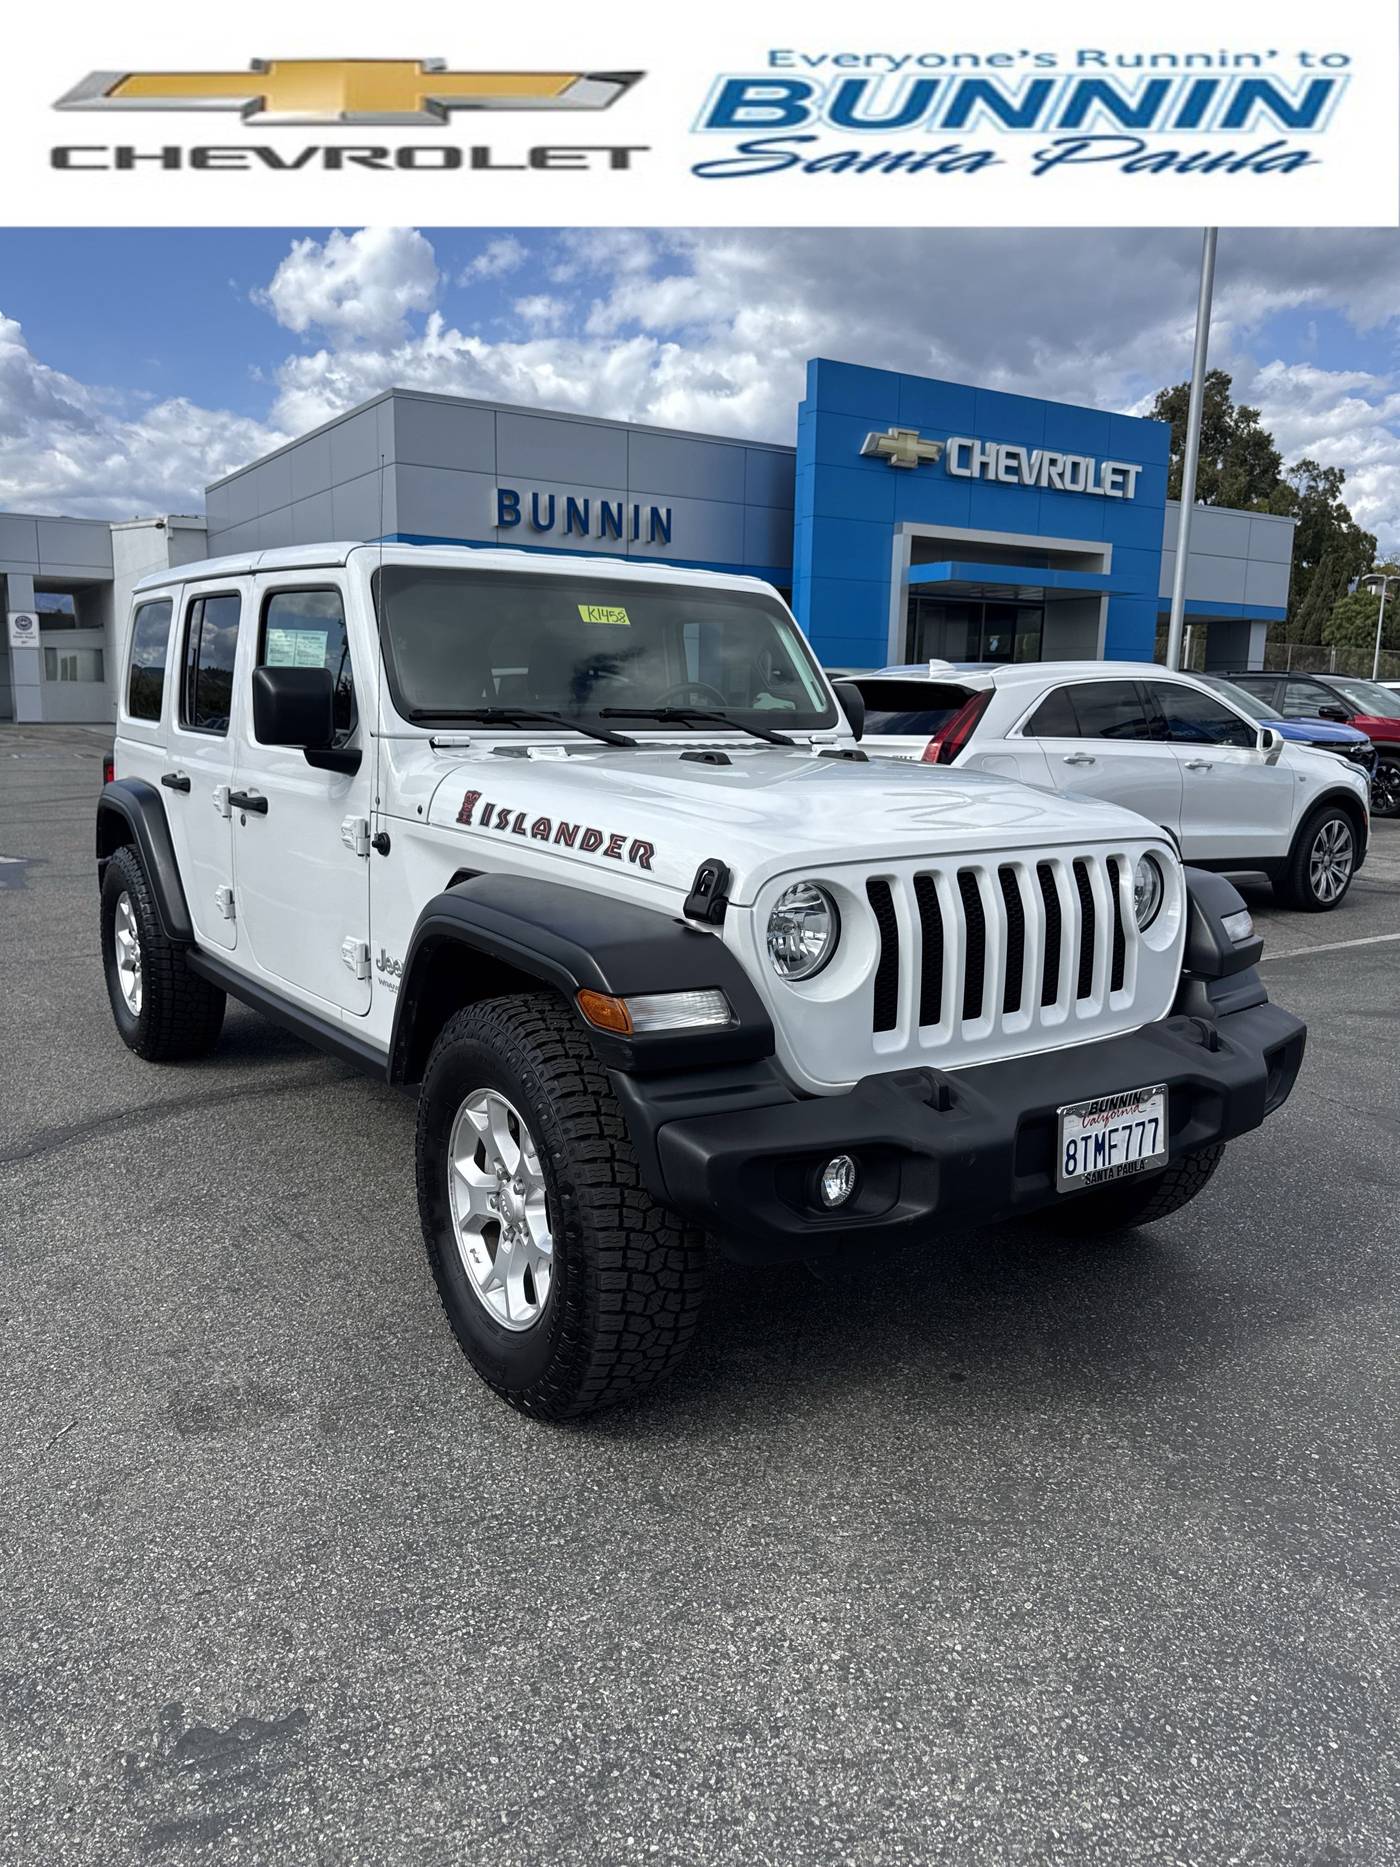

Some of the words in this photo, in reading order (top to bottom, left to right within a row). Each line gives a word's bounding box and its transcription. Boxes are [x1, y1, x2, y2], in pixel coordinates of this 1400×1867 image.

[946, 436, 1143, 499] CHEVROLET
[497, 488, 672, 544] BUNNIN
[587, 605, 627, 624] K1458
[479, 803, 655, 871] ISLANDER
[376, 948, 404, 978] Jee
[1081, 1104, 1147, 1128] California
[1088, 1090, 1143, 1115] BUNNIN
[1065, 1117, 1159, 1175] 8TMF777
[1084, 1168, 1115, 1185] SANTA
[1116, 1158, 1146, 1177] PAULA
